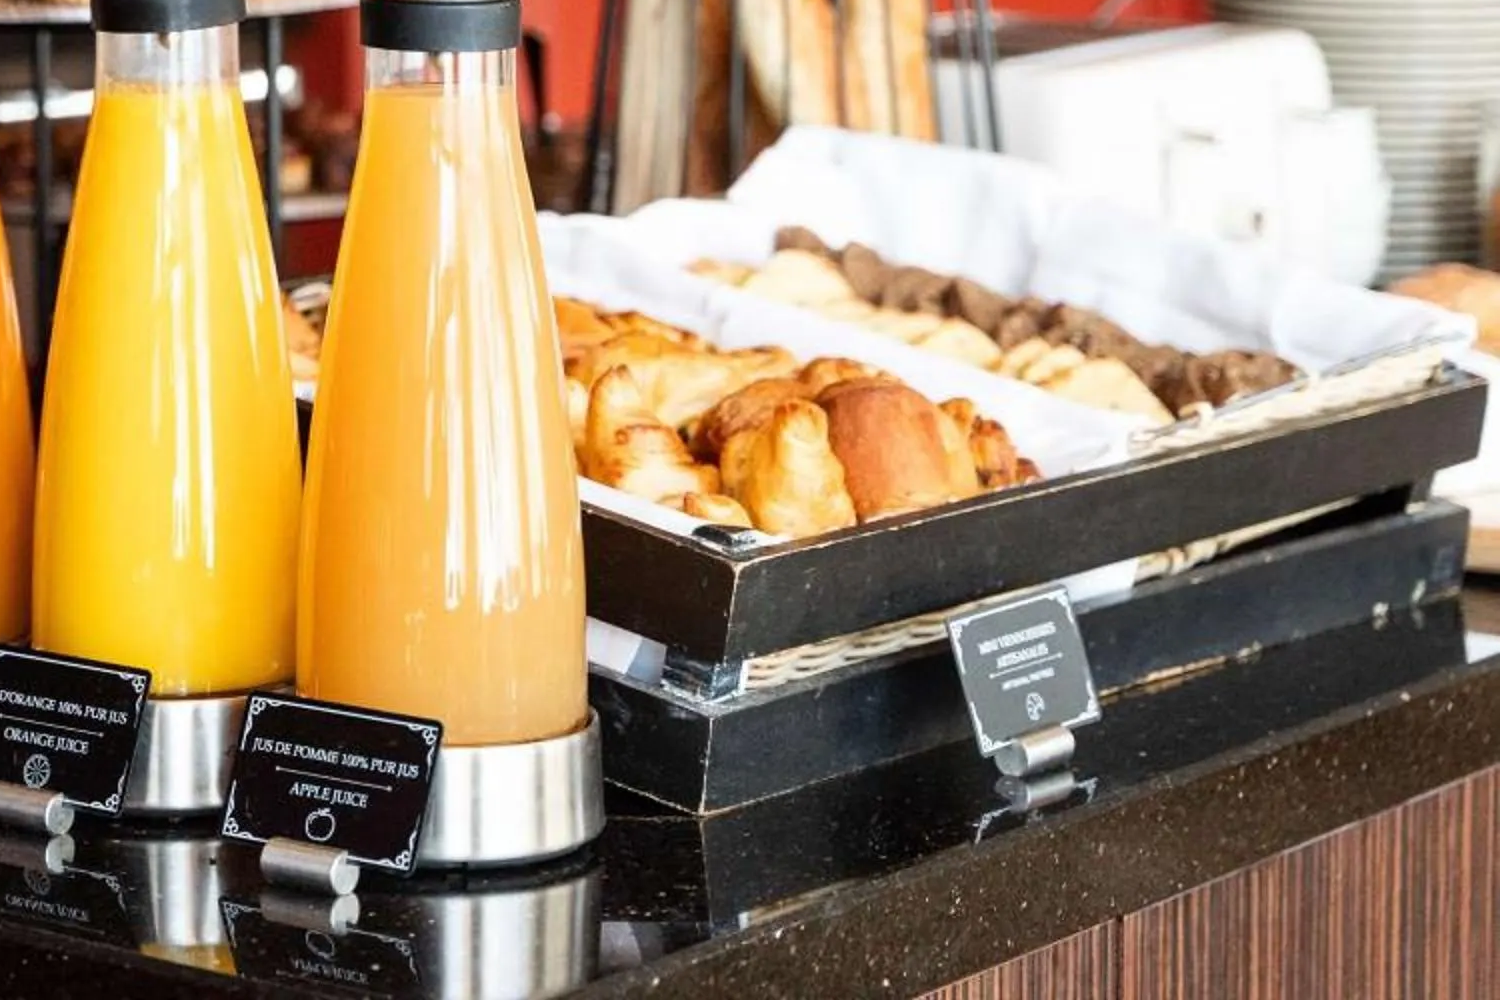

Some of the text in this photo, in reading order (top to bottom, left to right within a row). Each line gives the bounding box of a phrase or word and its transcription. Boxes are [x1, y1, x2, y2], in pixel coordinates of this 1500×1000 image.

[0, 689, 57, 711] D'ORANGE
[57, 701, 83, 717] 100%
[84, 705, 107, 721] PUR
[107, 711, 129, 725] JUS
[3, 727, 90, 755] ORANGE JUICE
[251, 737, 420, 779] JUS DE POMME 100% PUR JUS
[288, 781, 369, 808] APPLE JUICE
